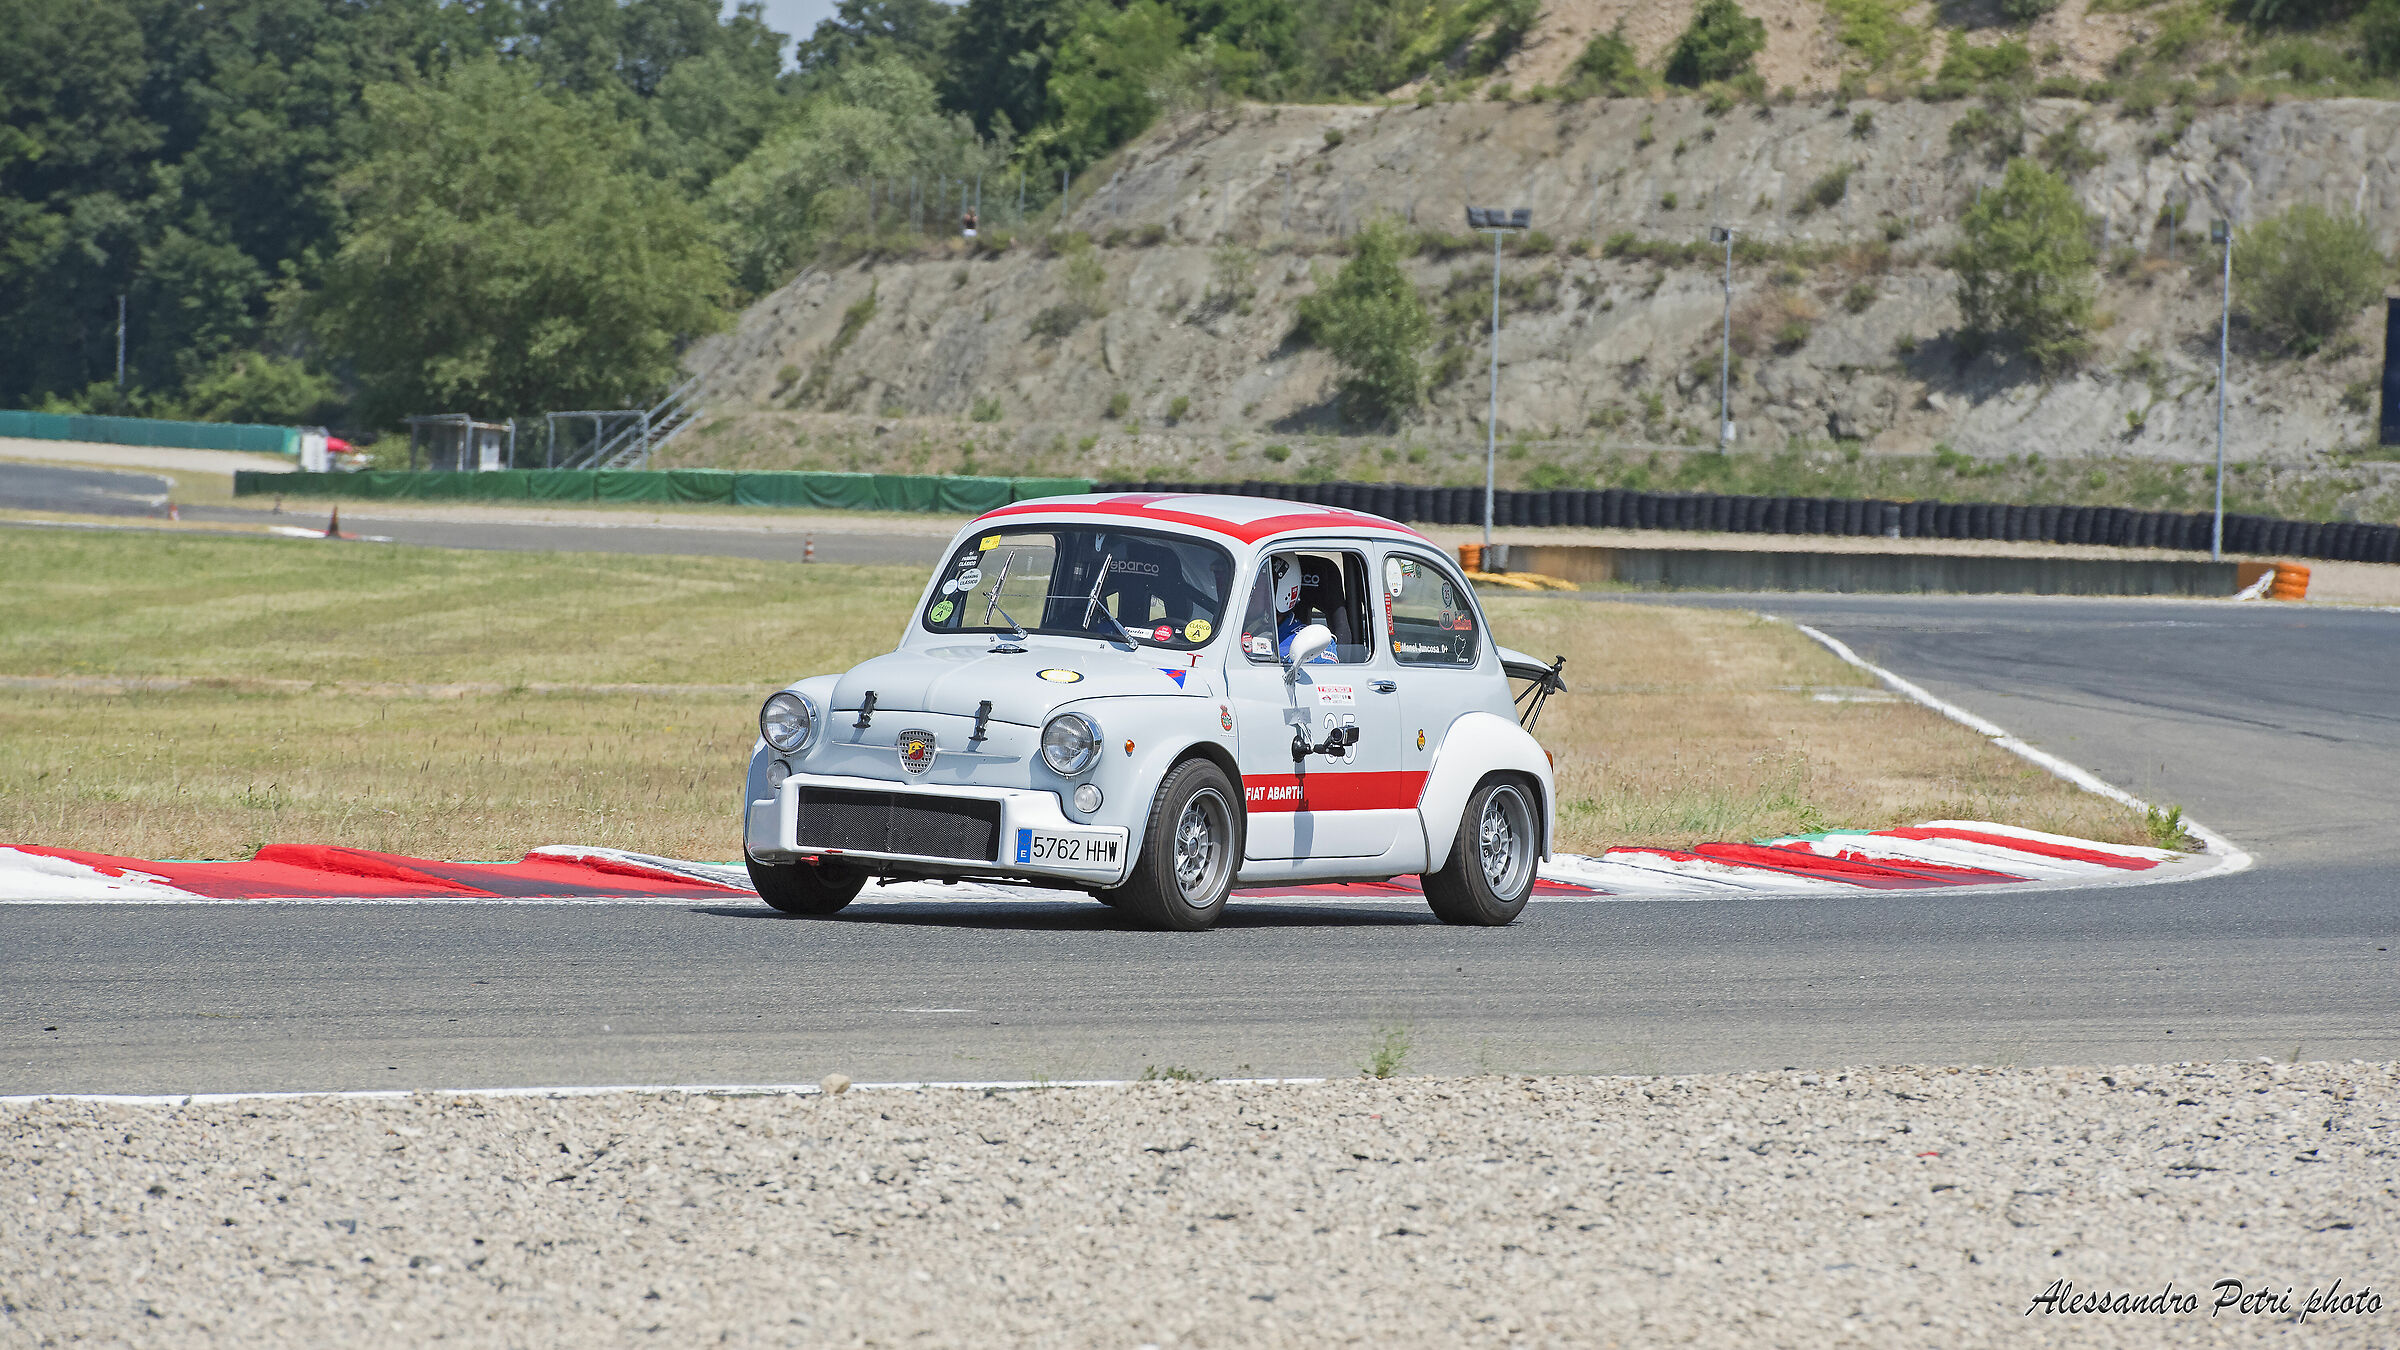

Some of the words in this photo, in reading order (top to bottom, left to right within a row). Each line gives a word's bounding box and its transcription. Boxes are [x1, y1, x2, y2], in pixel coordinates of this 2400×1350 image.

[1110, 560, 1160, 573] sparco
[1192, 629, 1201, 637] A
[1245, 786, 1266, 801] FIAT
[1267, 786, 1304, 801] ABARTH
[1020, 849, 1027, 858] E
[1033, 836, 1081, 860] 5762
[1086, 840, 1118, 862] HHW
